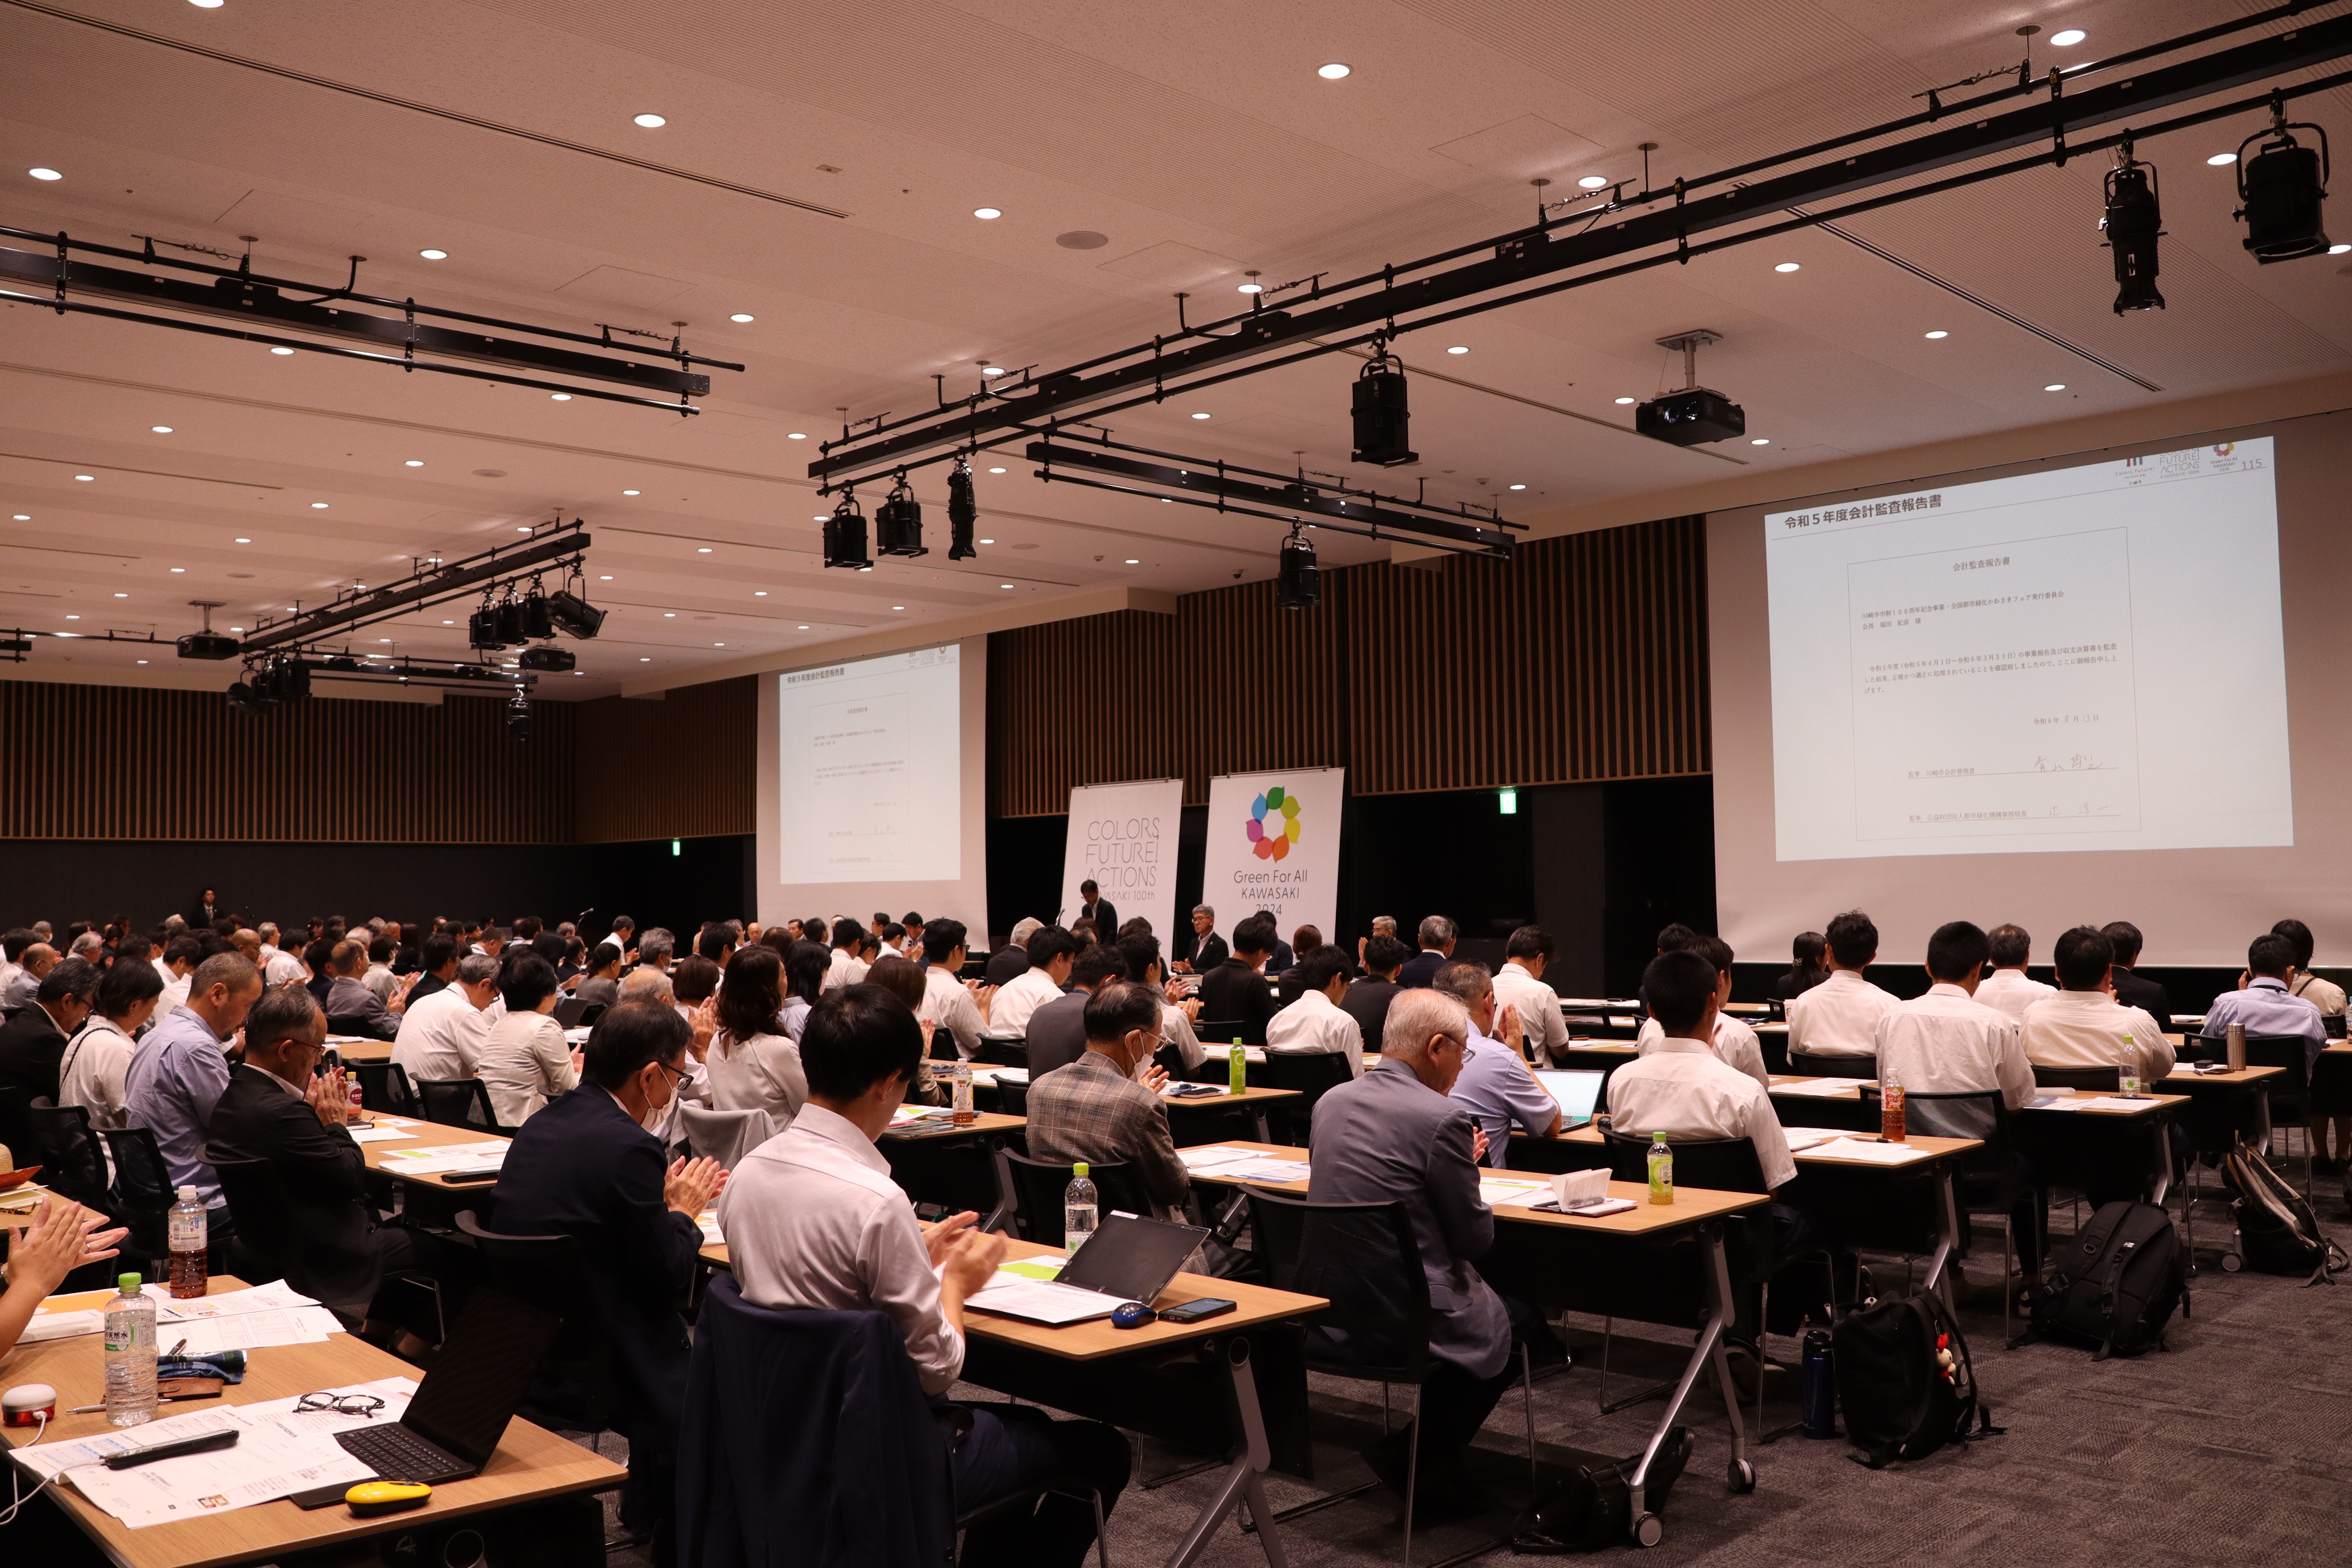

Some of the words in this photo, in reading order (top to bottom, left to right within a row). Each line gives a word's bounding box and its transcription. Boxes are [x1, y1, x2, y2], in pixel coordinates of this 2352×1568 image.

[2160, 451, 2200, 465] FUTURE!
[2160, 461, 2200, 474] ACTIONS
[2242, 459, 2262, 470] 115
[1785, 494, 1942, 529] 令和5年度会計監査報告書
[1953, 556, 2010, 571] 会計監査報告書
[1926, 767, 1975, 777] 川崎市会計管理者
[1927, 811, 2027, 821] 公益財団法人都市緑化機構事務局長
[1086, 841, 1159, 864] FUTURE!
[1234, 871, 1269, 883] Green
[1274, 870, 1291, 882] For
[1294, 869, 1307, 882] All
[1134, 891, 1155, 900] 100th
[1242, 887, 1299, 899] KAWASAKI
[1256, 904, 1282, 915] 2024
